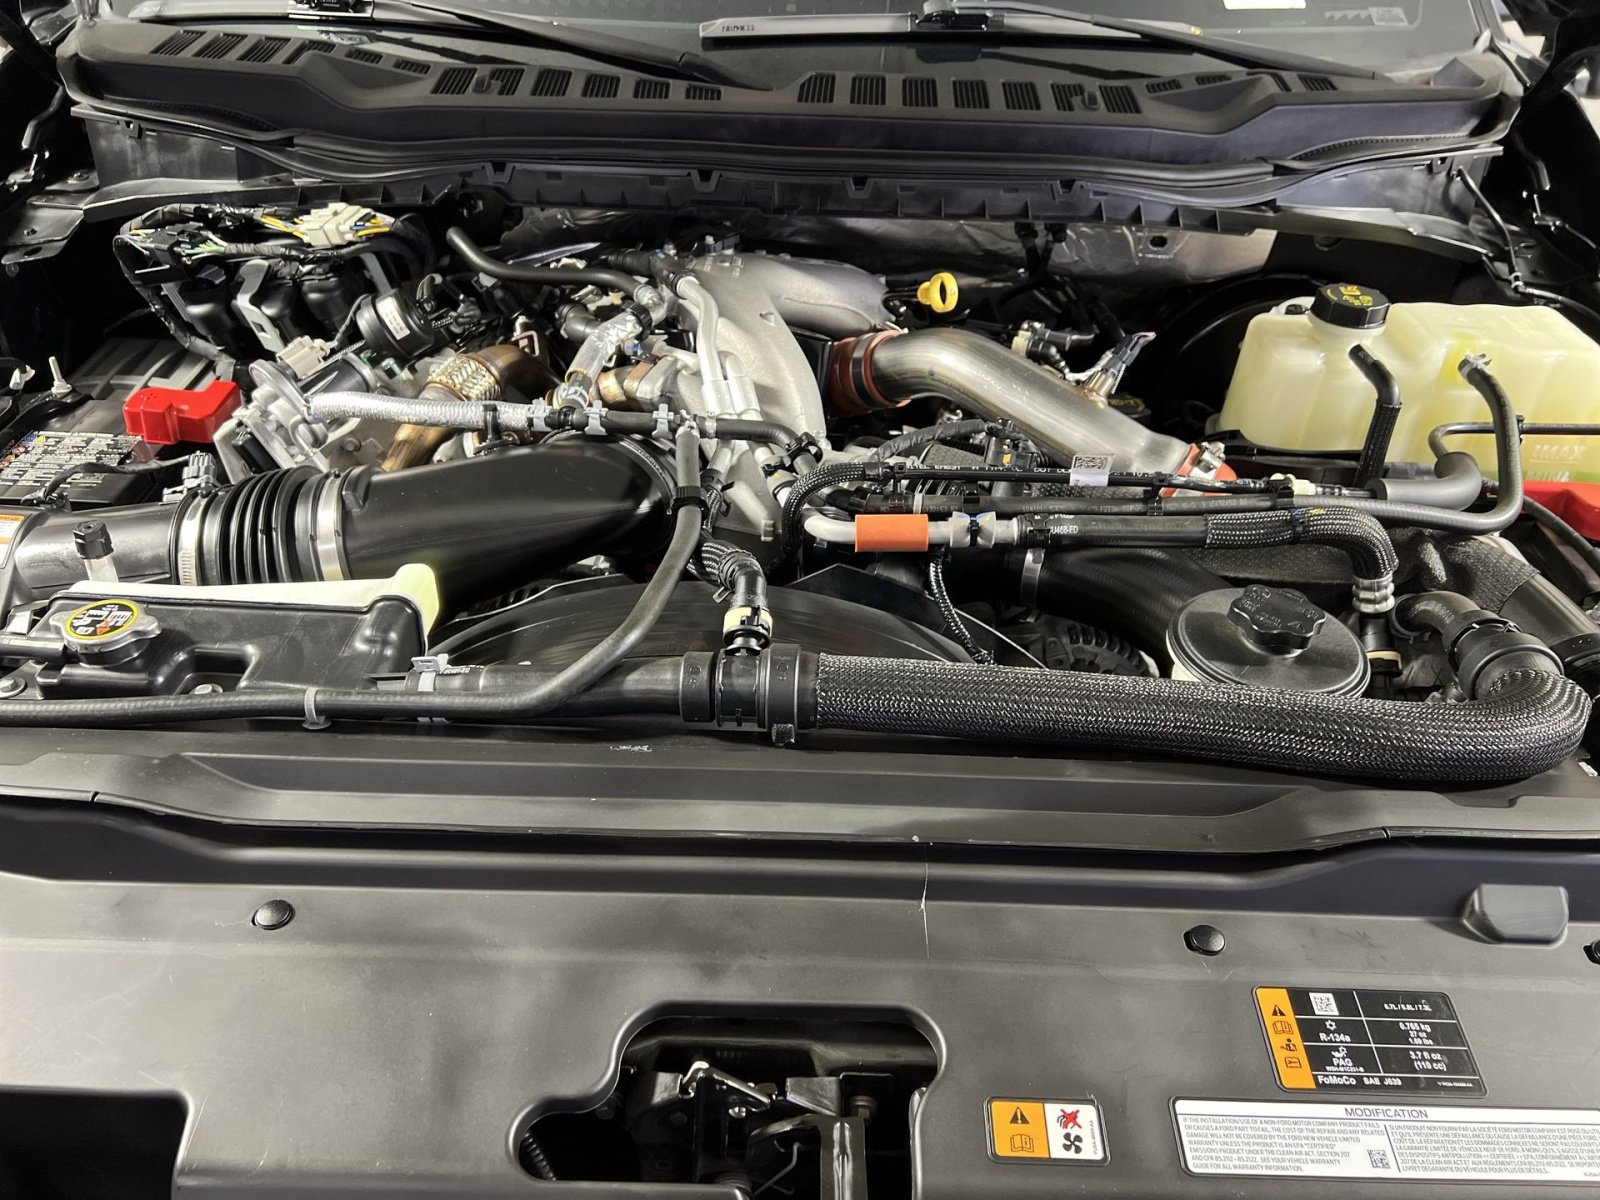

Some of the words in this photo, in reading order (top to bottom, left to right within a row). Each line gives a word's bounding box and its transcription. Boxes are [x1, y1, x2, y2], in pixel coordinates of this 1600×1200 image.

[1420, 1023, 1431, 1032] kg
[1319, 1032, 1351, 1042] R-134a
[1409, 1051, 1422, 1060] 3.7
[1332, 1058, 1352, 1066] PAG
[1414, 1062, 1431, 1071] (110
[1432, 1062, 1446, 1072] cc)
[1318, 1076, 1356, 1085] FoMoCo
[1344, 1108, 1428, 1118] MODIFICATION
